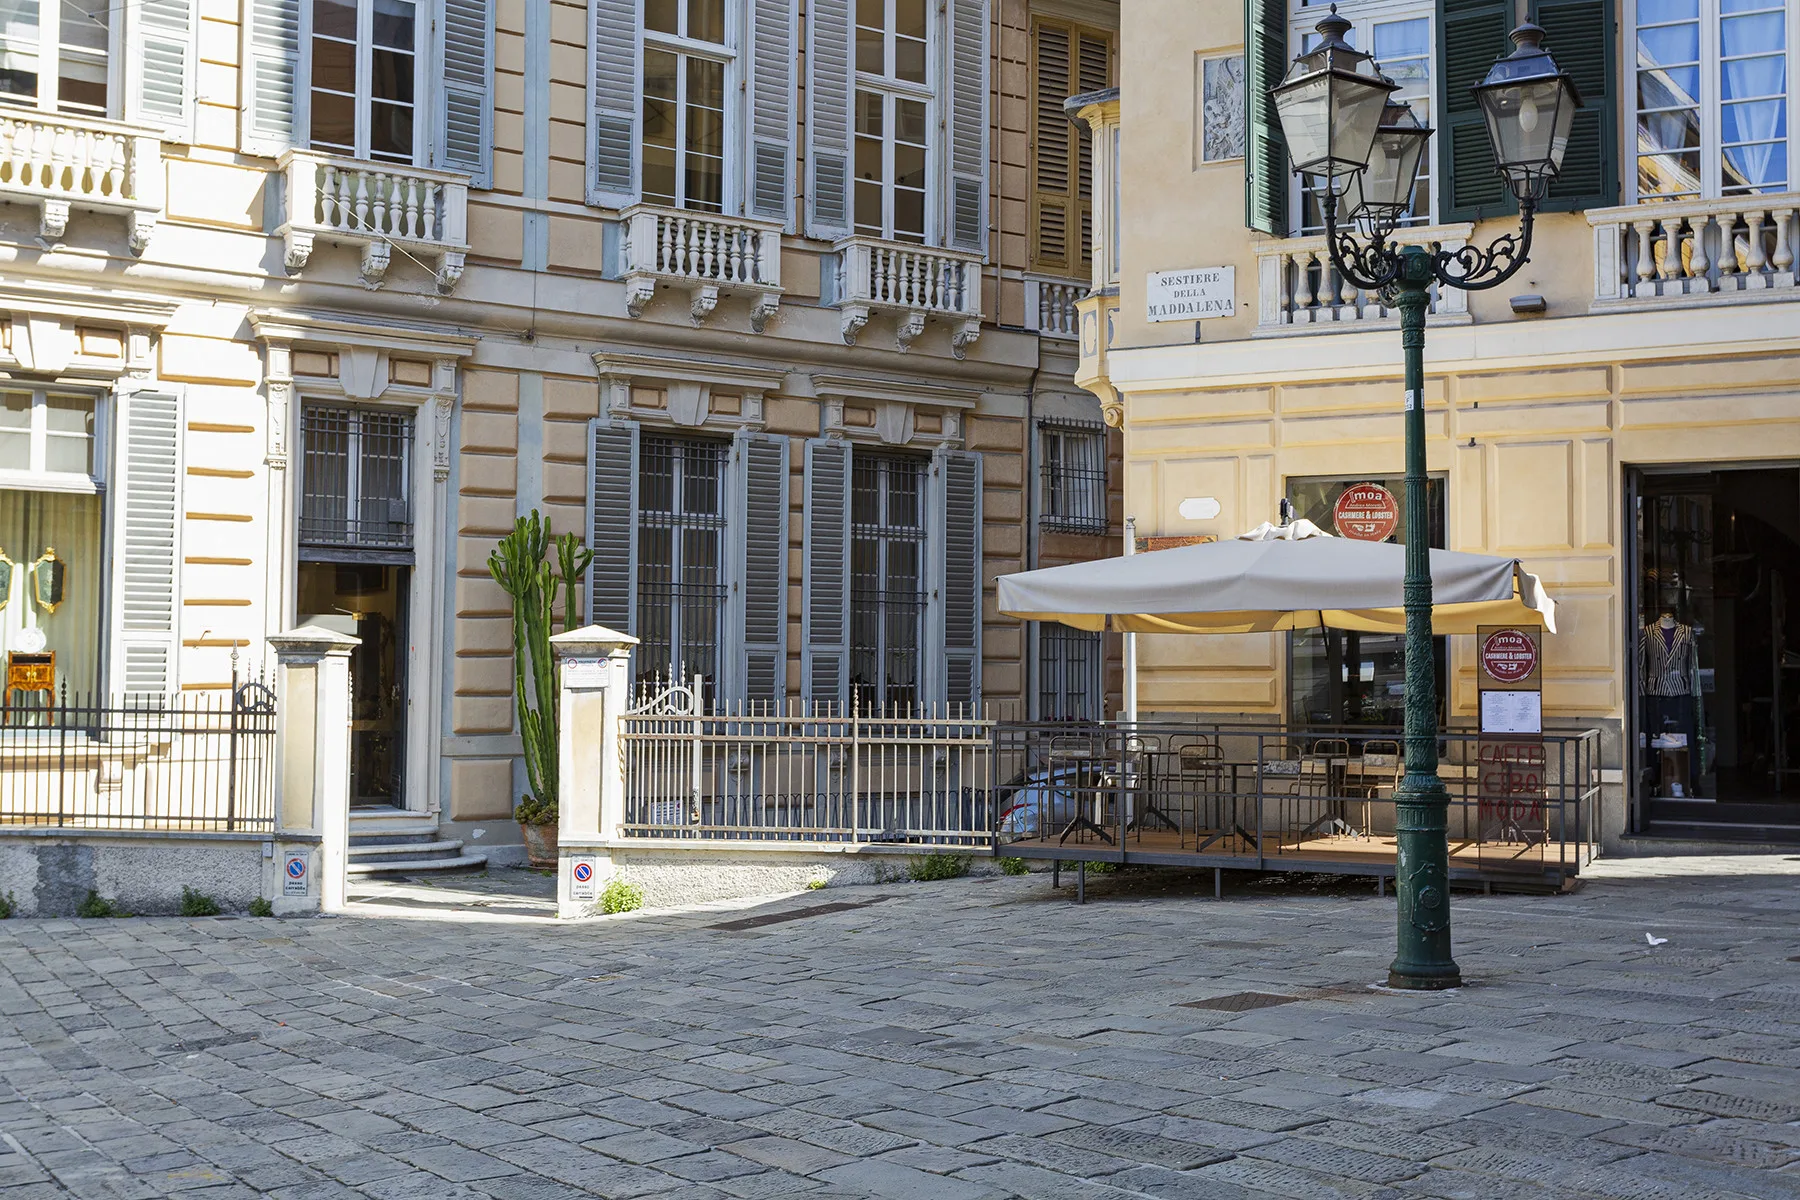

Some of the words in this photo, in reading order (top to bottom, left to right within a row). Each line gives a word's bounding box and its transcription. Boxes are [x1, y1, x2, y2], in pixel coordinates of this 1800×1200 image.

[1161, 273, 1220, 287] SESTIERE
[1174, 289, 1206, 298] DELLA
[1148, 299, 1233, 316] MADDALENA
[1365, 510, 1372, 520] &
[1508, 652, 1514, 660] &
[1483, 772, 1538, 793] CIBO
[1480, 800, 1541, 822] MODA
